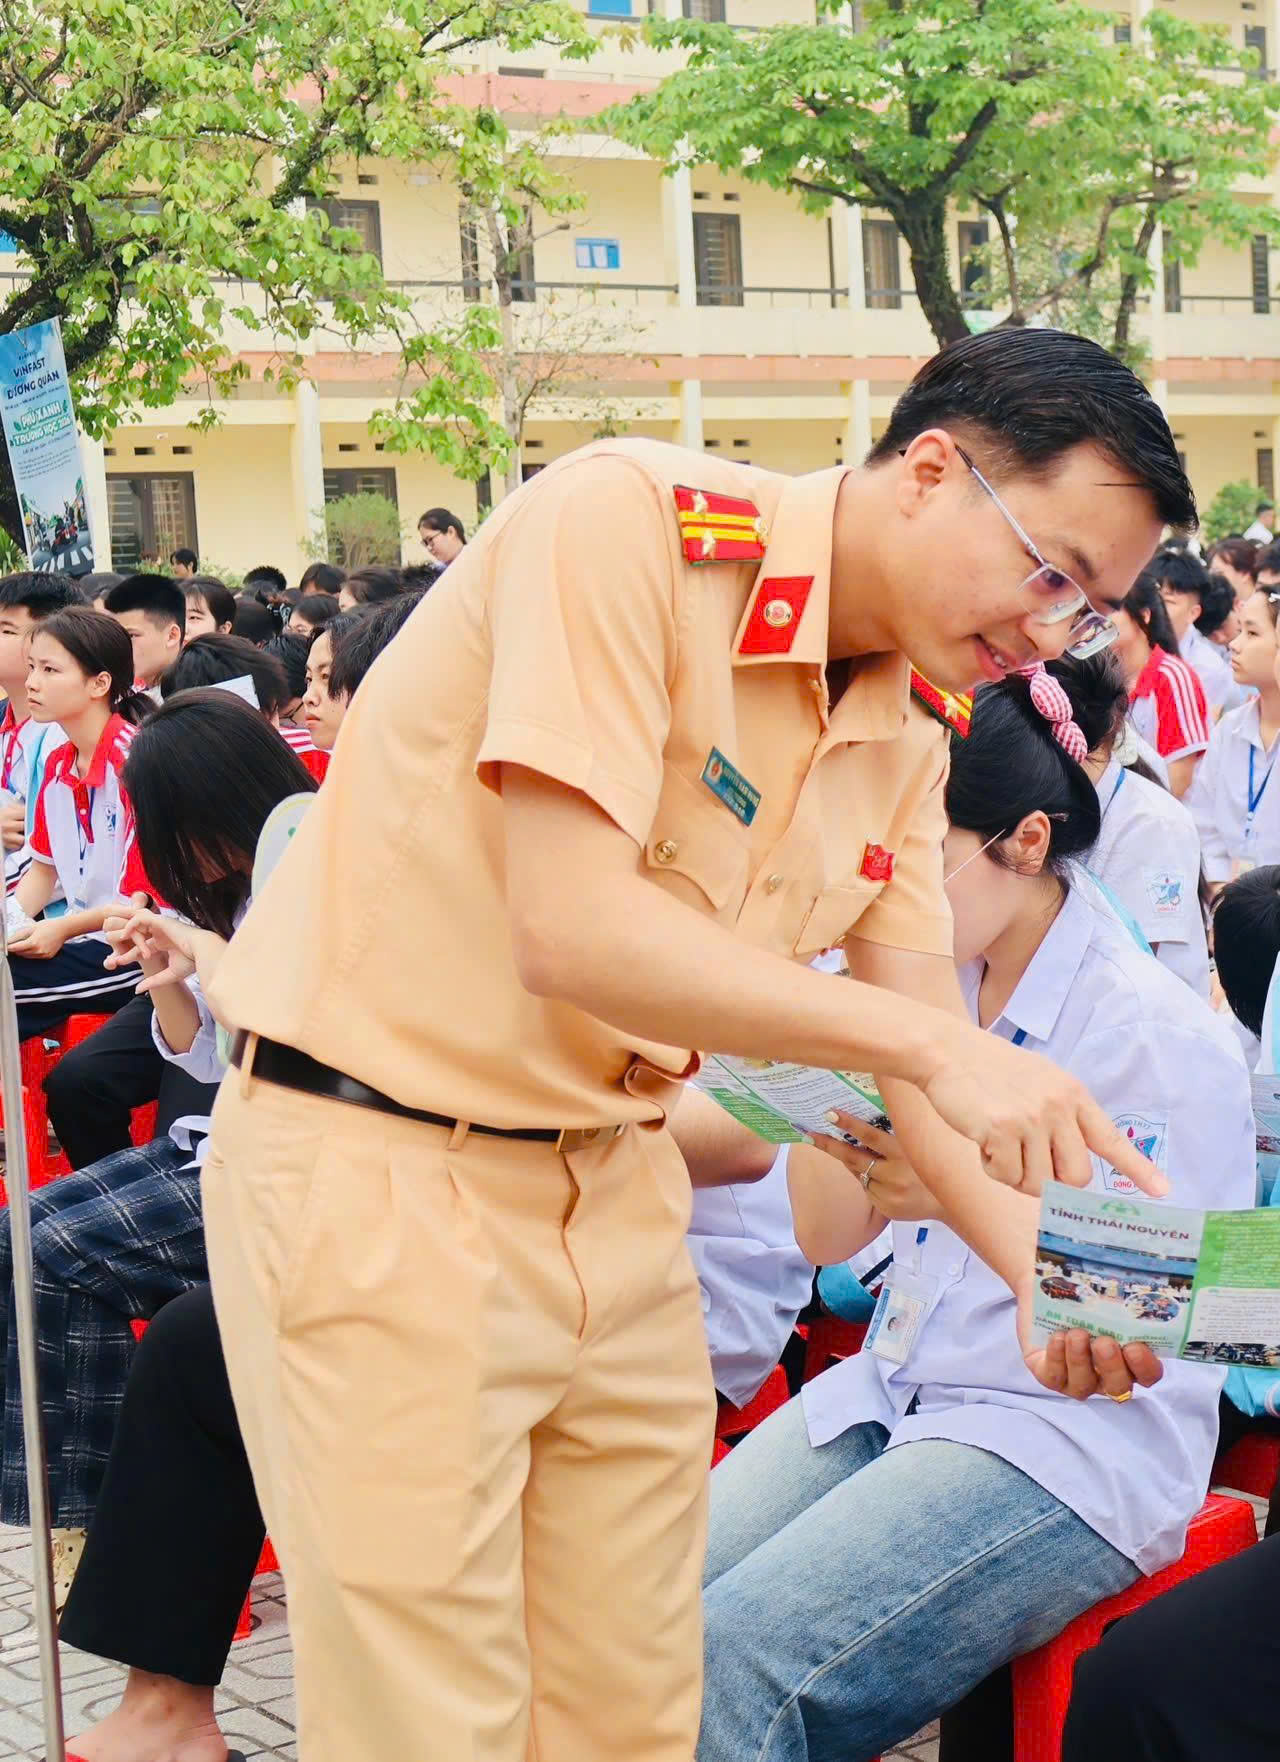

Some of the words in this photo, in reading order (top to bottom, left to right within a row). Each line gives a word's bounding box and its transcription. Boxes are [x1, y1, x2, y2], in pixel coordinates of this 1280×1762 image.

[13, 357, 46, 378] VINFAST
[1049, 1207, 1083, 1222] TỈNH
[1088, 1216, 1122, 1229] THÁI
[1126, 1223, 1190, 1240] NGUYÊN
